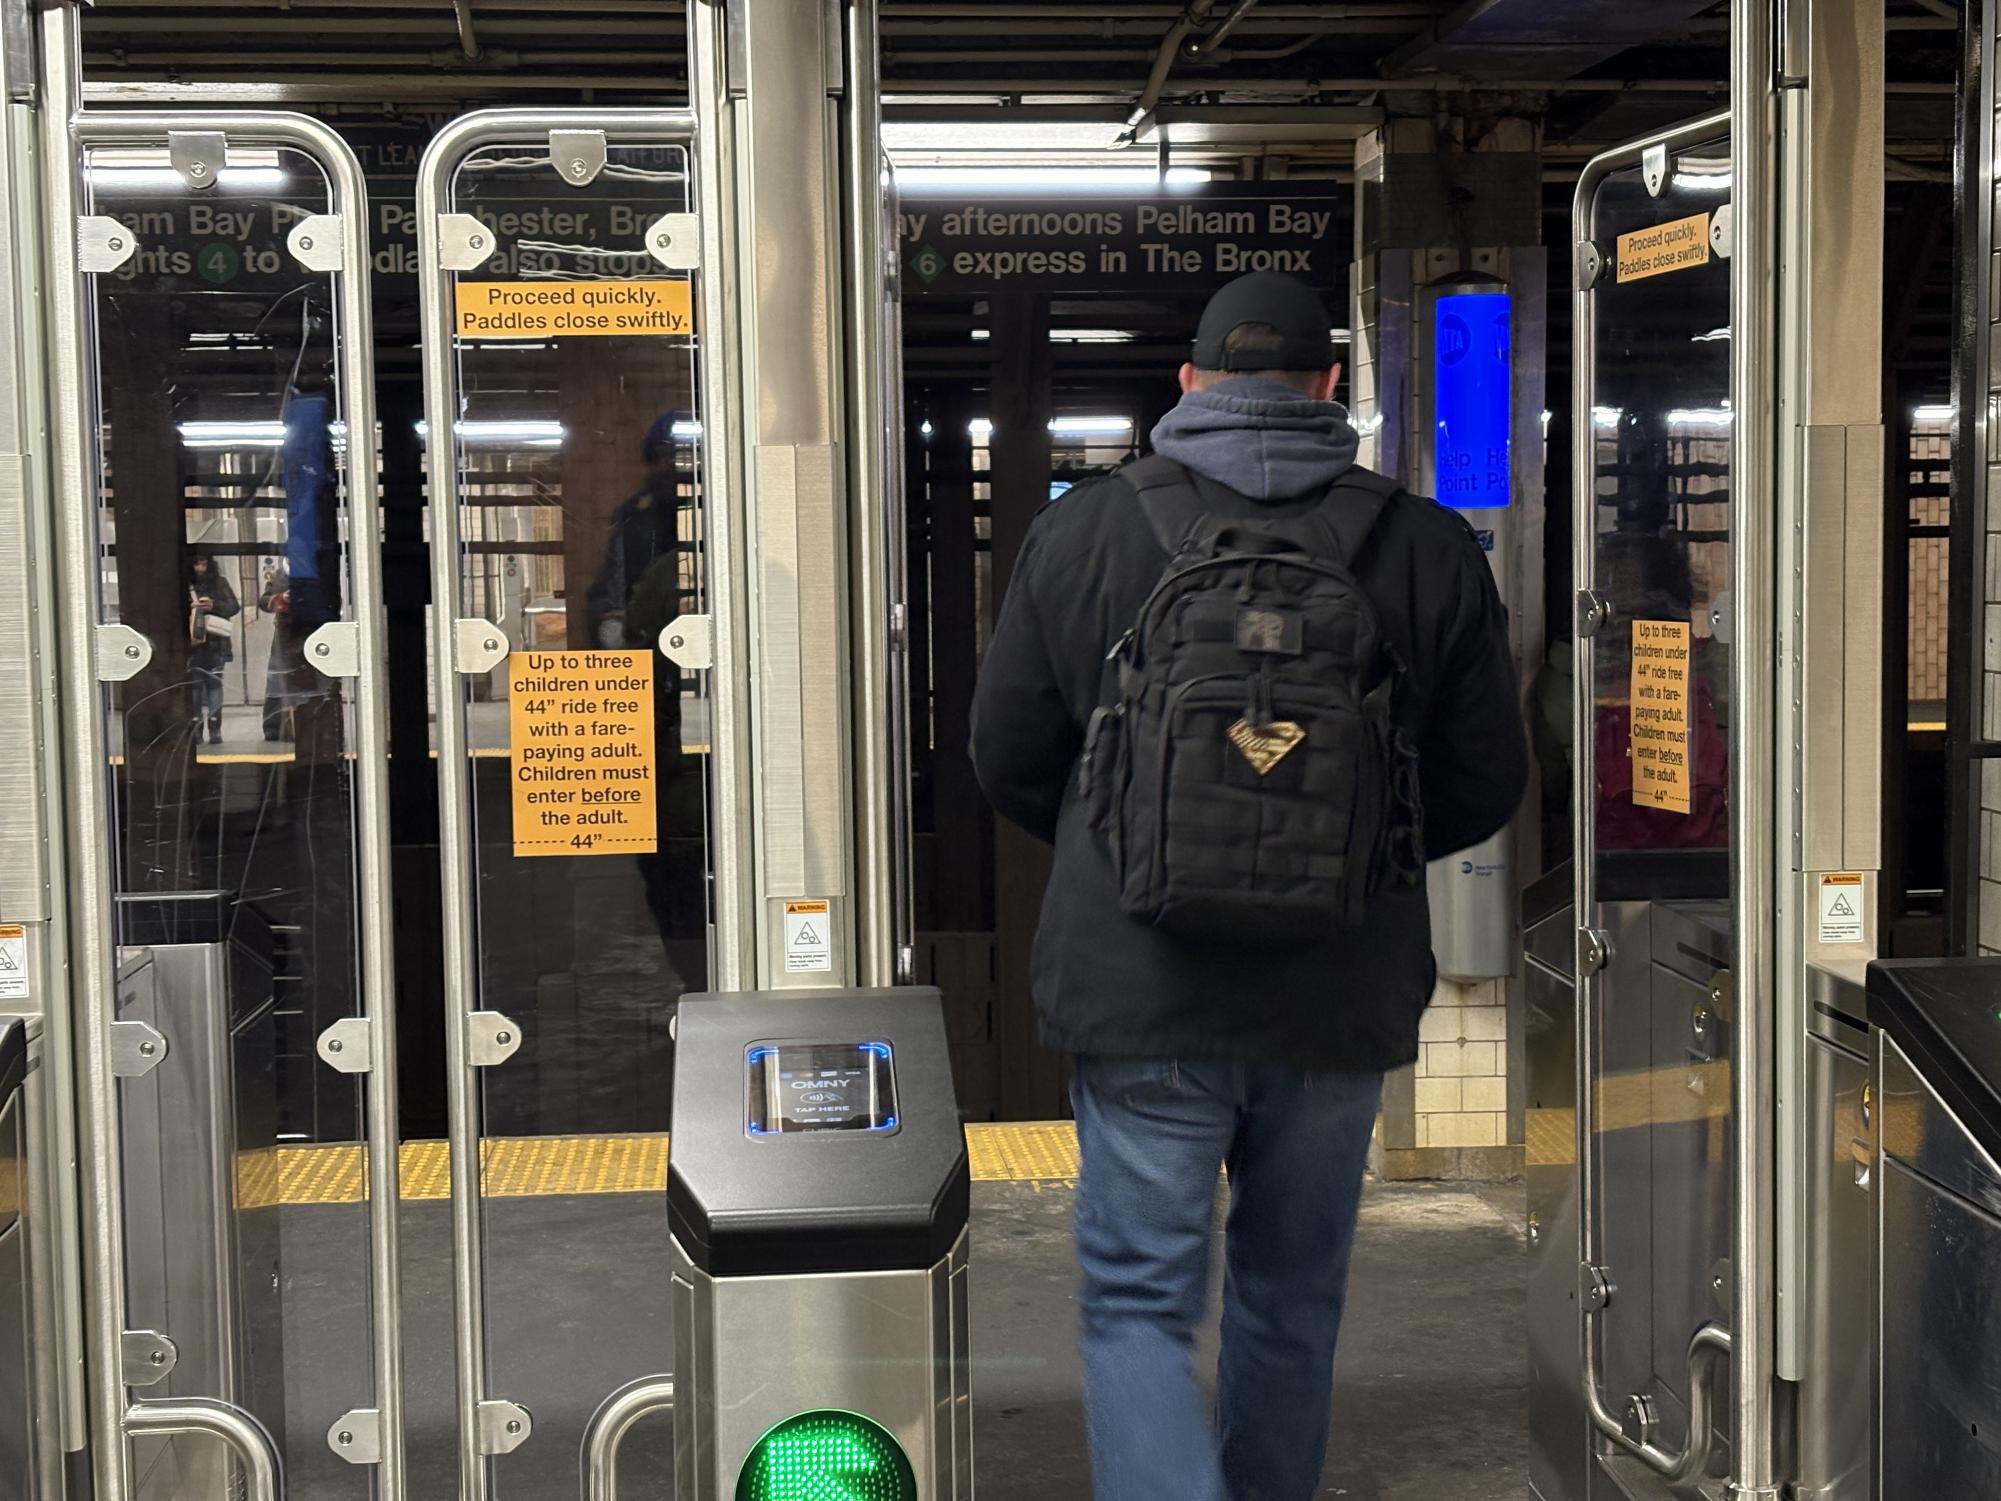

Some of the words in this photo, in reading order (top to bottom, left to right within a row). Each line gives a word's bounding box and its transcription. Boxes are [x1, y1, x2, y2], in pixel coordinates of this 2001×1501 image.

[189, 204, 255, 240] Bay
[942, 206, 1123, 236] afternoons
[1136, 204, 1255, 235] Pelham
[1268, 204, 1331, 240] Bay
[1628, 230, 1662, 253] Proceed
[1664, 223, 1697, 247] quickly.
[207, 252, 226, 274] 4
[244, 246, 280, 274] to
[488, 244, 561, 274] also
[920, 253, 937, 275] 6
[953, 250, 1087, 280] express
[1100, 244, 1127, 273] in
[1140, 243, 1203, 273] The
[1215, 243, 1312, 272] Bronx
[1619, 256, 1651, 276] Paddles
[1653, 252, 1676, 269] close
[1678, 243, 1708, 262] swiftly.
[488, 288, 575, 305] Proceed
[582, 287, 662, 307] quickly.
[463, 312, 547, 330] Paddles
[554, 312, 609, 329] close
[616, 311, 689, 331] swiftly.
[1440, 473, 1478, 492] Point
[1639, 624, 1650, 640] Up
[1652, 625, 1659, 638] to
[1661, 624, 1681, 639] three
[1633, 646, 1664, 659] children
[1665, 647, 1688, 660] under
[528, 654, 555, 672] Up
[560, 656, 579, 669] to
[585, 654, 633, 668] three
[1651, 665, 1667, 679] ride
[1668, 666, 1683, 680] free
[514, 677, 589, 692] children
[595, 676, 649, 691] under
[1639, 686, 1654, 699] with
[1656, 689, 1661, 699] a
[1662, 687, 1681, 701] fare-
[561, 699, 597, 713] ride
[602, 698, 639, 712] free
[1635, 707, 1660, 722] paying
[1662, 708, 1683, 722] adult.
[529, 722, 568, 736] with
[574, 725, 585, 736] a
[591, 721, 635, 735] fare-
[1633, 724, 1665, 741] Children
[1667, 729, 1686, 744] must
[523, 744, 584, 762] paying
[591, 743, 642, 757] adult.
[1637, 747, 1657, 759] enter
[1659, 750, 1683, 764] before
[518, 766, 596, 781] Children
[602, 765, 649, 780] must
[1643, 767, 1656, 780] the
[1657, 768, 1678, 783] adult.
[527, 790, 576, 803] enter
[581, 788, 641, 803] before
[541, 811, 570, 825] the
[576, 809, 628, 824] adult.
[791, 1079, 850, 1089] OMNY
